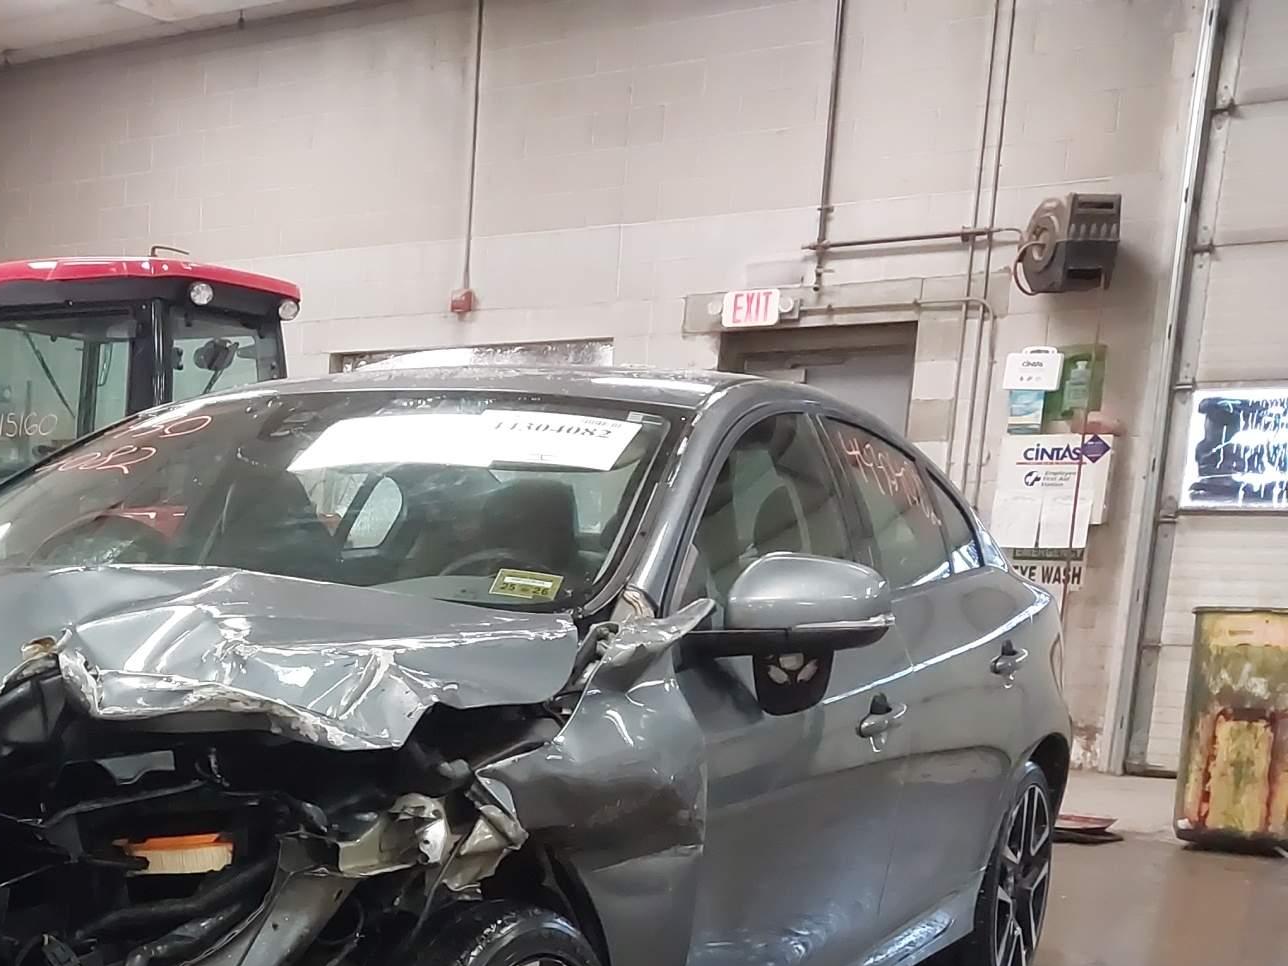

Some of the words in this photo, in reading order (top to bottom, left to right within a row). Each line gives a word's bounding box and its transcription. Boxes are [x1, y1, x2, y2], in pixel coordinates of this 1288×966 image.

[732, 291, 773, 323] EXIT
[1023, 443, 1081, 461] CINTAS
[1012, 565, 1037, 581] YE
[1041, 566, 1082, 585] WASH
